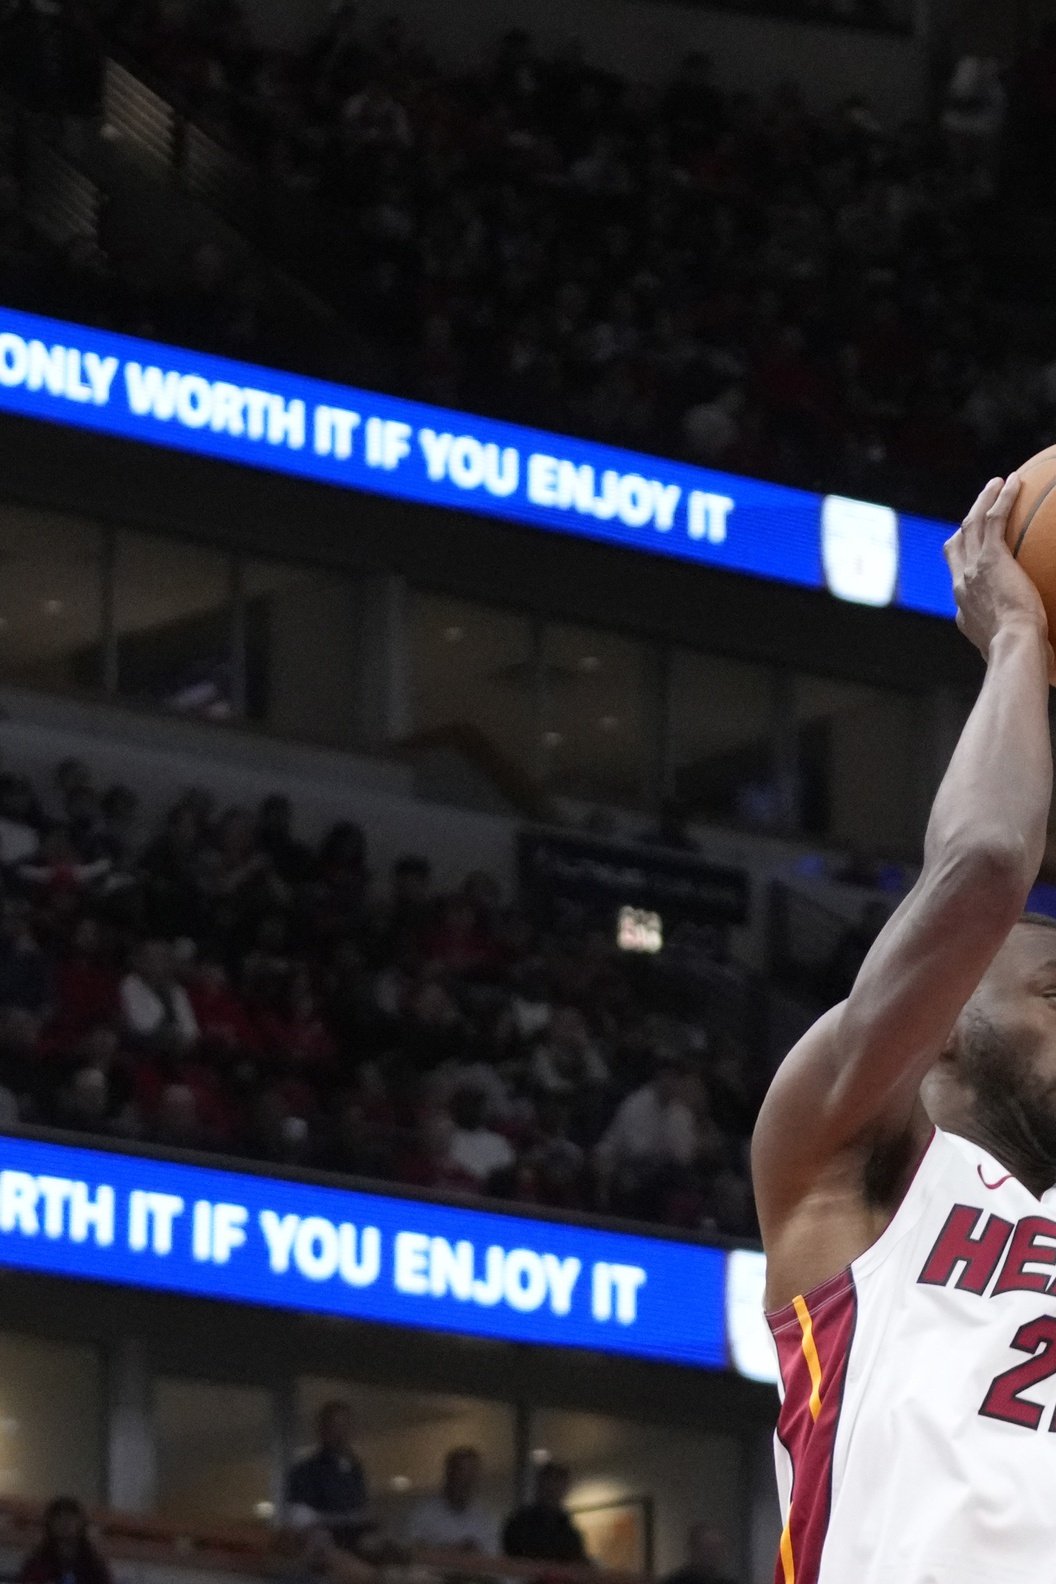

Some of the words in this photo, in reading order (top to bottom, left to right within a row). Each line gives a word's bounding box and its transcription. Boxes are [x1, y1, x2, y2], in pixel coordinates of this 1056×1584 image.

[0, 332, 119, 404] ONLY
[125, 362, 305, 449] WORTH
[314, 405, 361, 460] IT
[366, 417, 412, 470] IF
[419, 428, 519, 496] YOU
[528, 453, 681, 531] ENJOY
[688, 490, 734, 543] IT
[128, 1190, 184, 1256] IT
[192, 1200, 248, 1264] IF
[260, 1210, 381, 1287] YOU
[394, 1231, 582, 1316] ENJOY
[592, 1262, 646, 1325] IT
